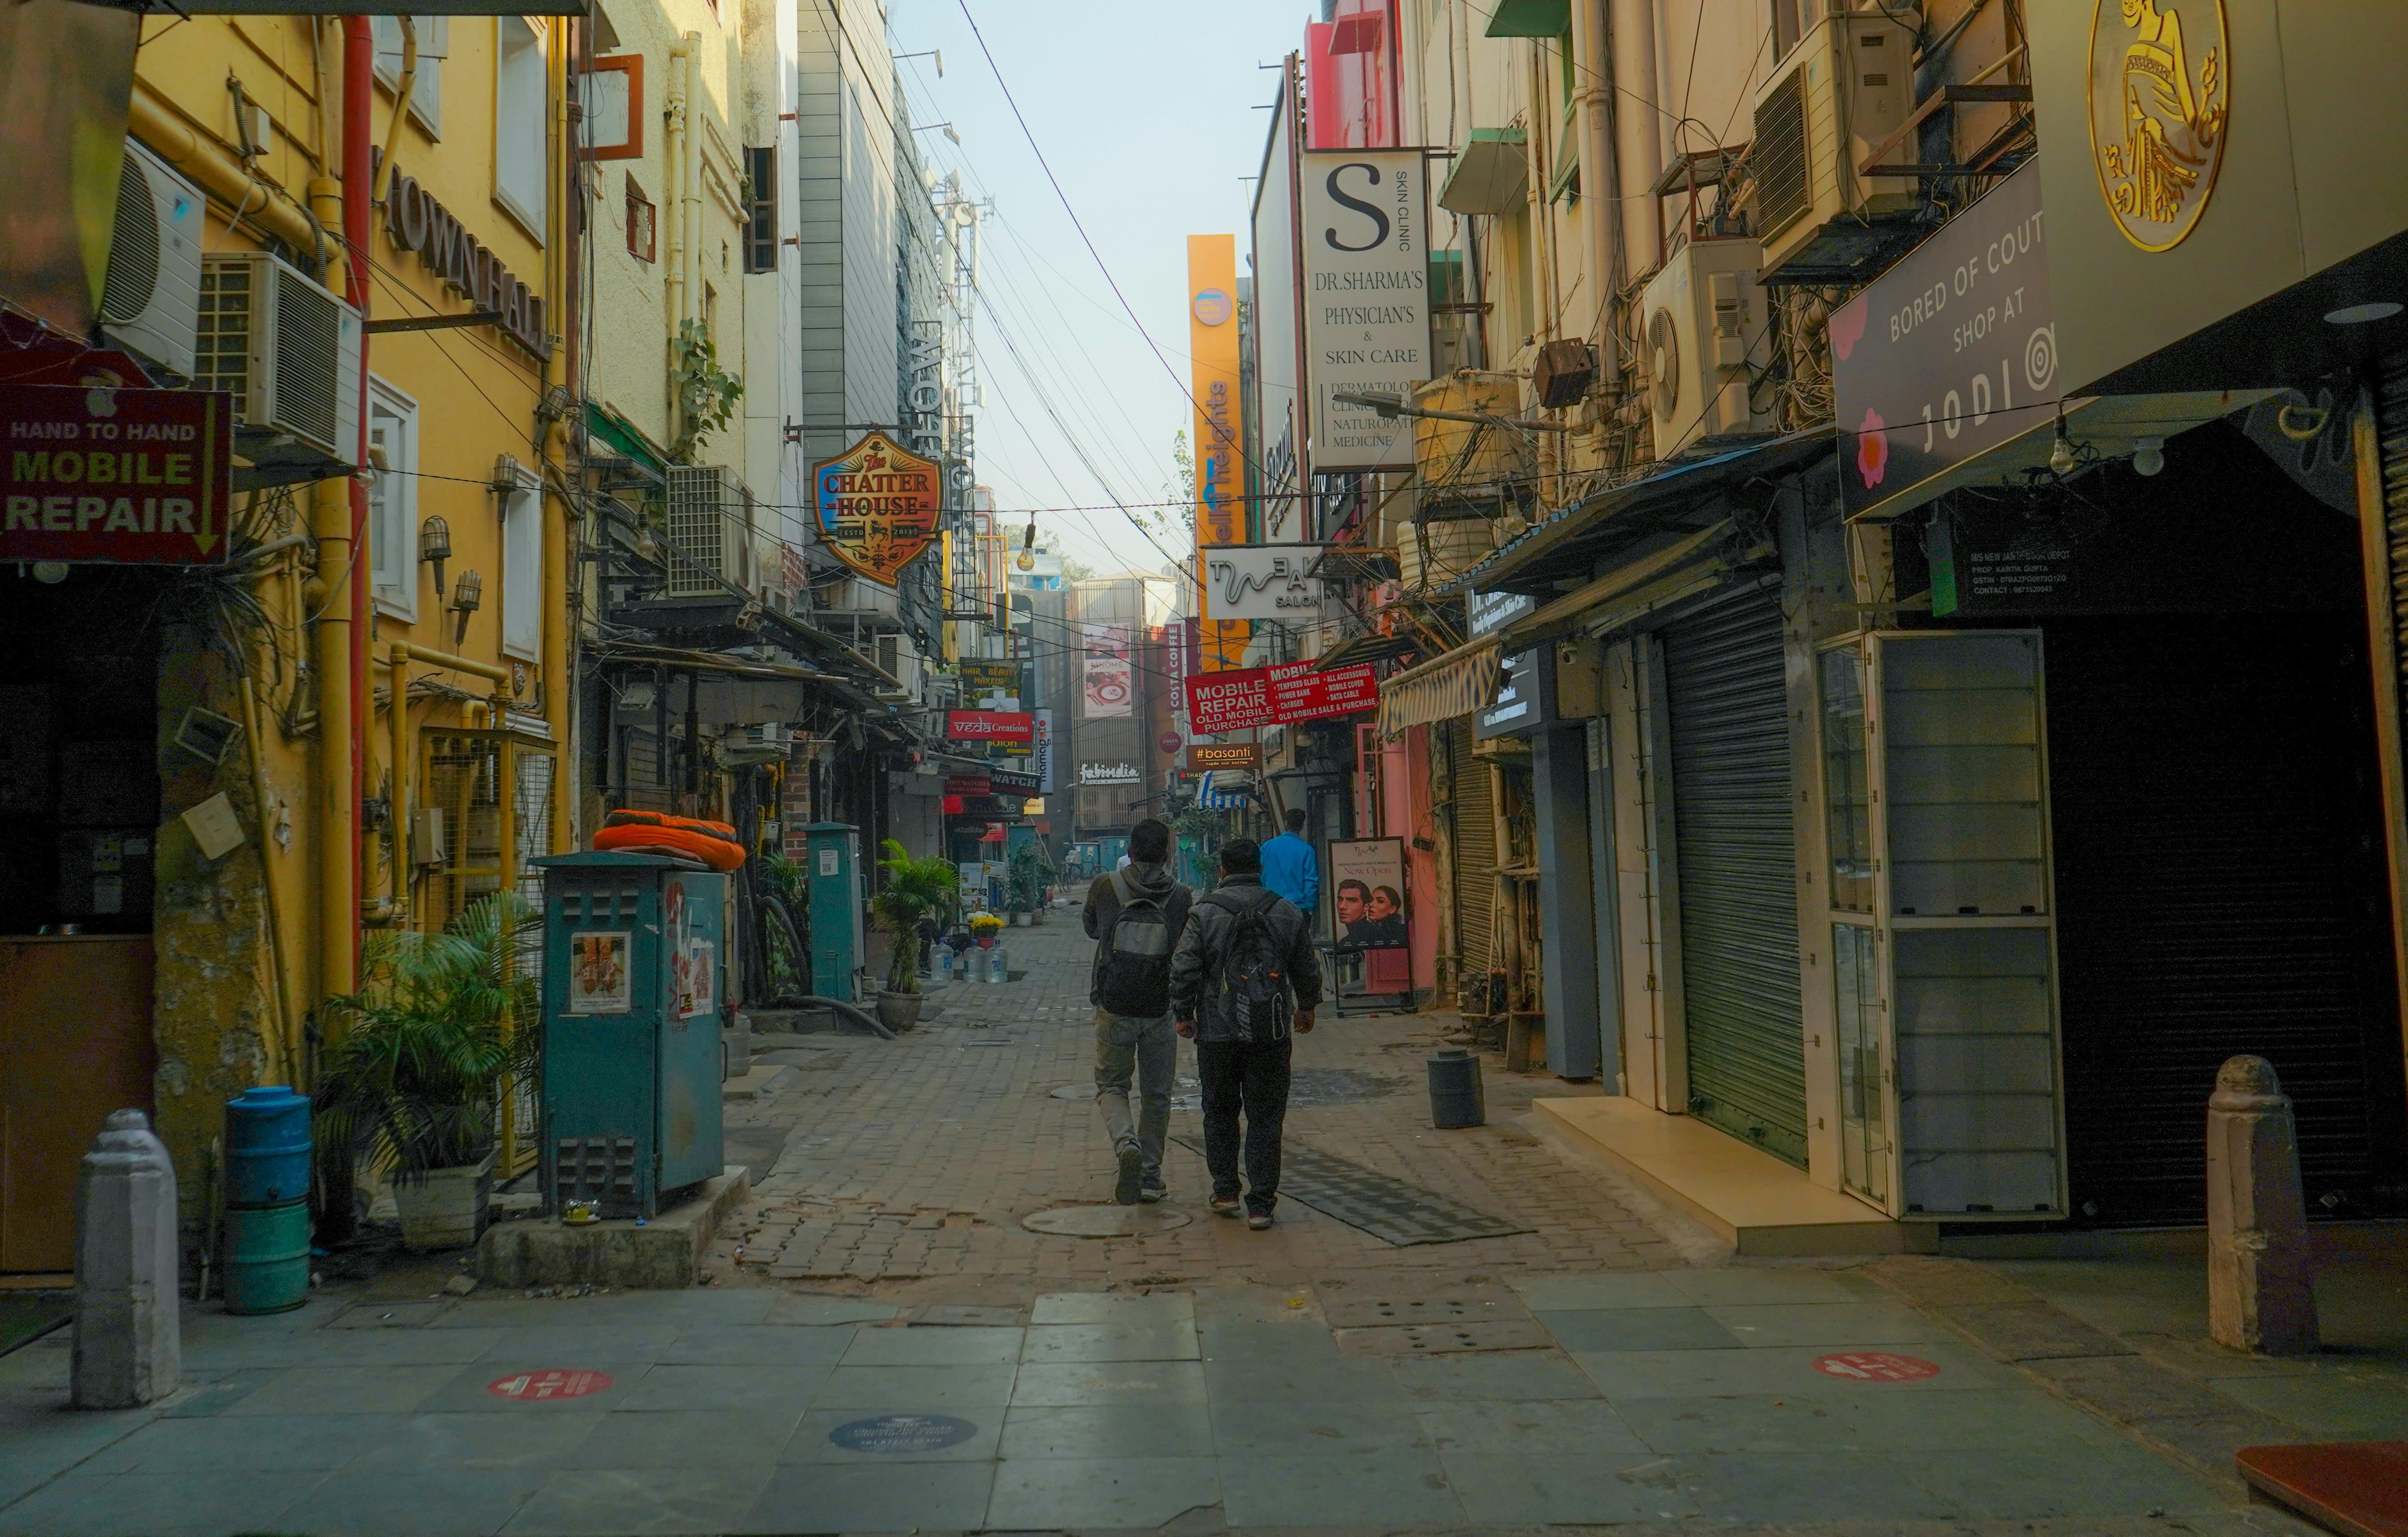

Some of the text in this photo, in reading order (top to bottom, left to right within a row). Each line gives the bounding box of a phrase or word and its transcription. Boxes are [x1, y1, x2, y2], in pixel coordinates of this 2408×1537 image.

[1396, 171, 1410, 252] SKIN CLINIC
[1891, 282, 1947, 342] BORED
[1955, 256, 1977, 296] OF
[1325, 306, 1414, 325] PHYSICIAN'S
[1954, 288, 2025, 353] SHOP AT
[1364, 331, 1372, 342] &
[1326, 349, 1417, 364] SKIN CARE
[1923, 359, 2012, 454] JODI
[10, 422, 196, 440] HAND TO HAND
[1333, 436, 1392, 447] MEDICINE
[13, 451, 192, 485] MOBILE
[864, 452, 886, 472] The
[1205, 381, 1235, 545] elhi heights
[823, 473, 929, 493] CHATTER
[5, 496, 194, 533] REPAIR
[836, 497, 918, 517] HOUSE
[1276, 596, 1320, 607] SALON
[1169, 627, 1179, 707] COSTA COFFEE
[1337, 669, 1370, 681] ACCESSORIES
[1196, 679, 1266, 700] MOBILE
[1277, 677, 1319, 691] TEMPERED GLASS
[1328, 680, 1364, 692] MOBILE COVER
[1279, 691, 1296, 699] POWER
[1344, 690, 1359, 698] CABLE
[1200, 694, 1267, 714] REPAIR
[1280, 700, 1304, 710] CHARGER
[1293, 709, 1317, 719] MOBILE
[1318, 705, 1335, 714] SALE
[1342, 698, 1375, 709] PURCHASE
[1196, 706, 1274, 724] OLD MOBILE
[992, 722, 1028, 733] Creations
[1197, 747, 1250, 759] #basanti
[992, 773, 1037, 788] WATCH
[1366, 866, 1391, 876] Open
